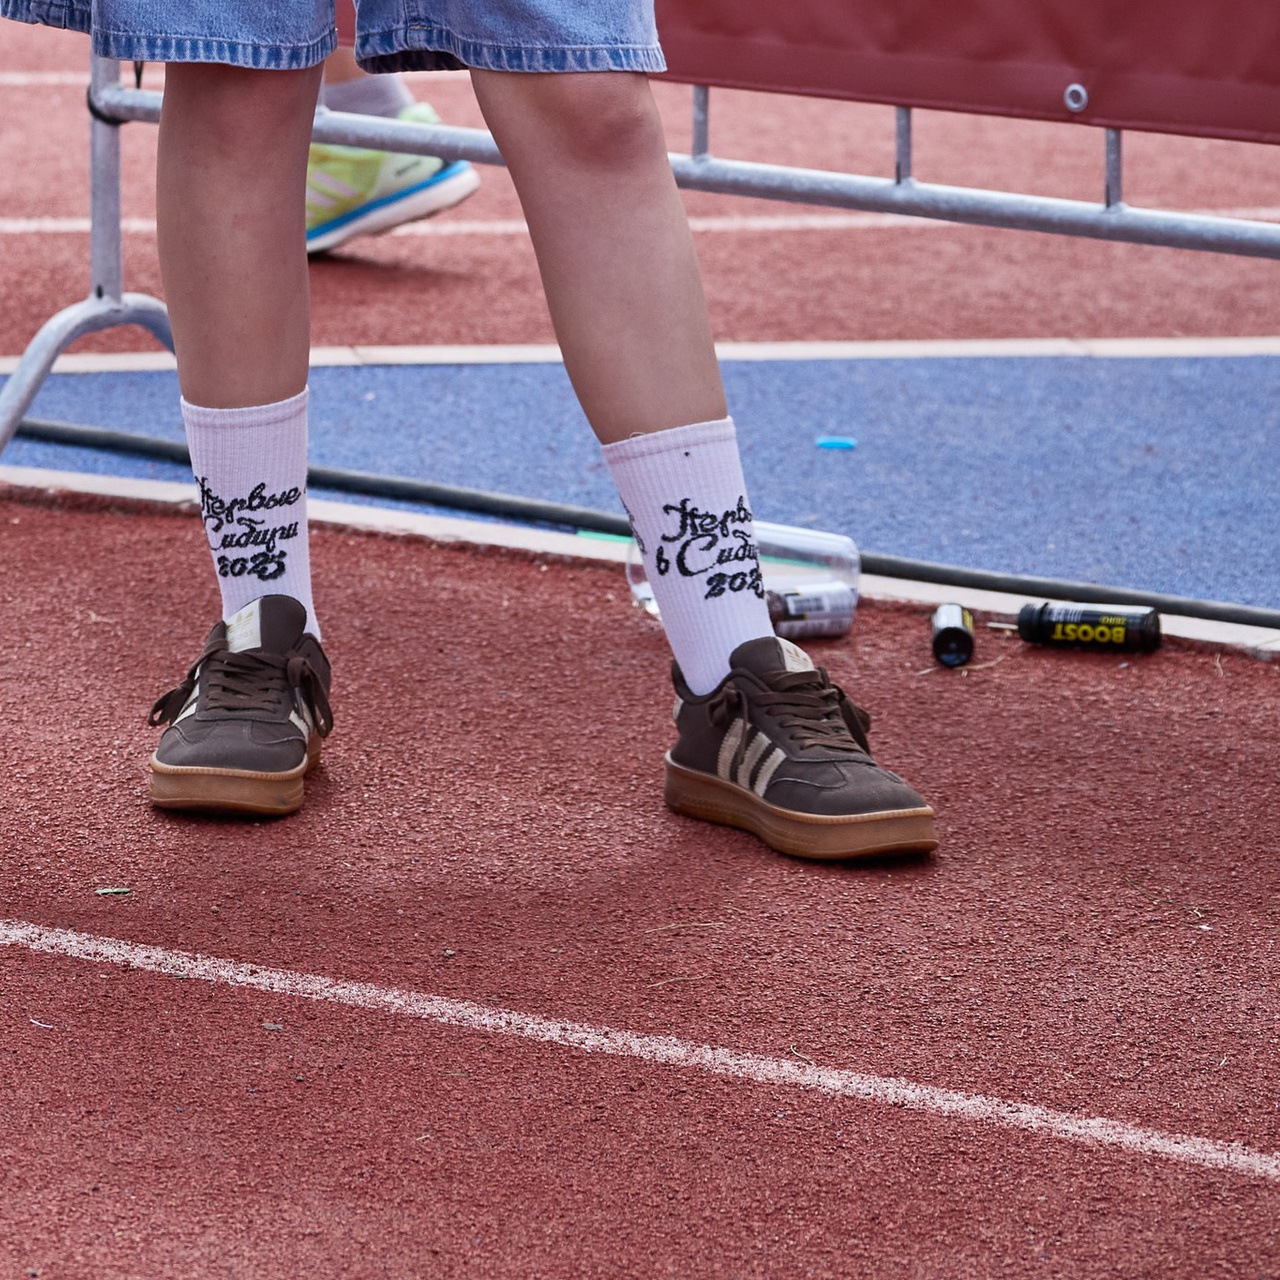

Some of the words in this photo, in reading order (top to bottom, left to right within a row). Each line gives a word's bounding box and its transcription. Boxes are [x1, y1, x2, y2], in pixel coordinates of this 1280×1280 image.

[217, 550, 287, 581] 2025
[705, 568, 764, 600] 202
[1051, 623, 1126, 644] BOOST
